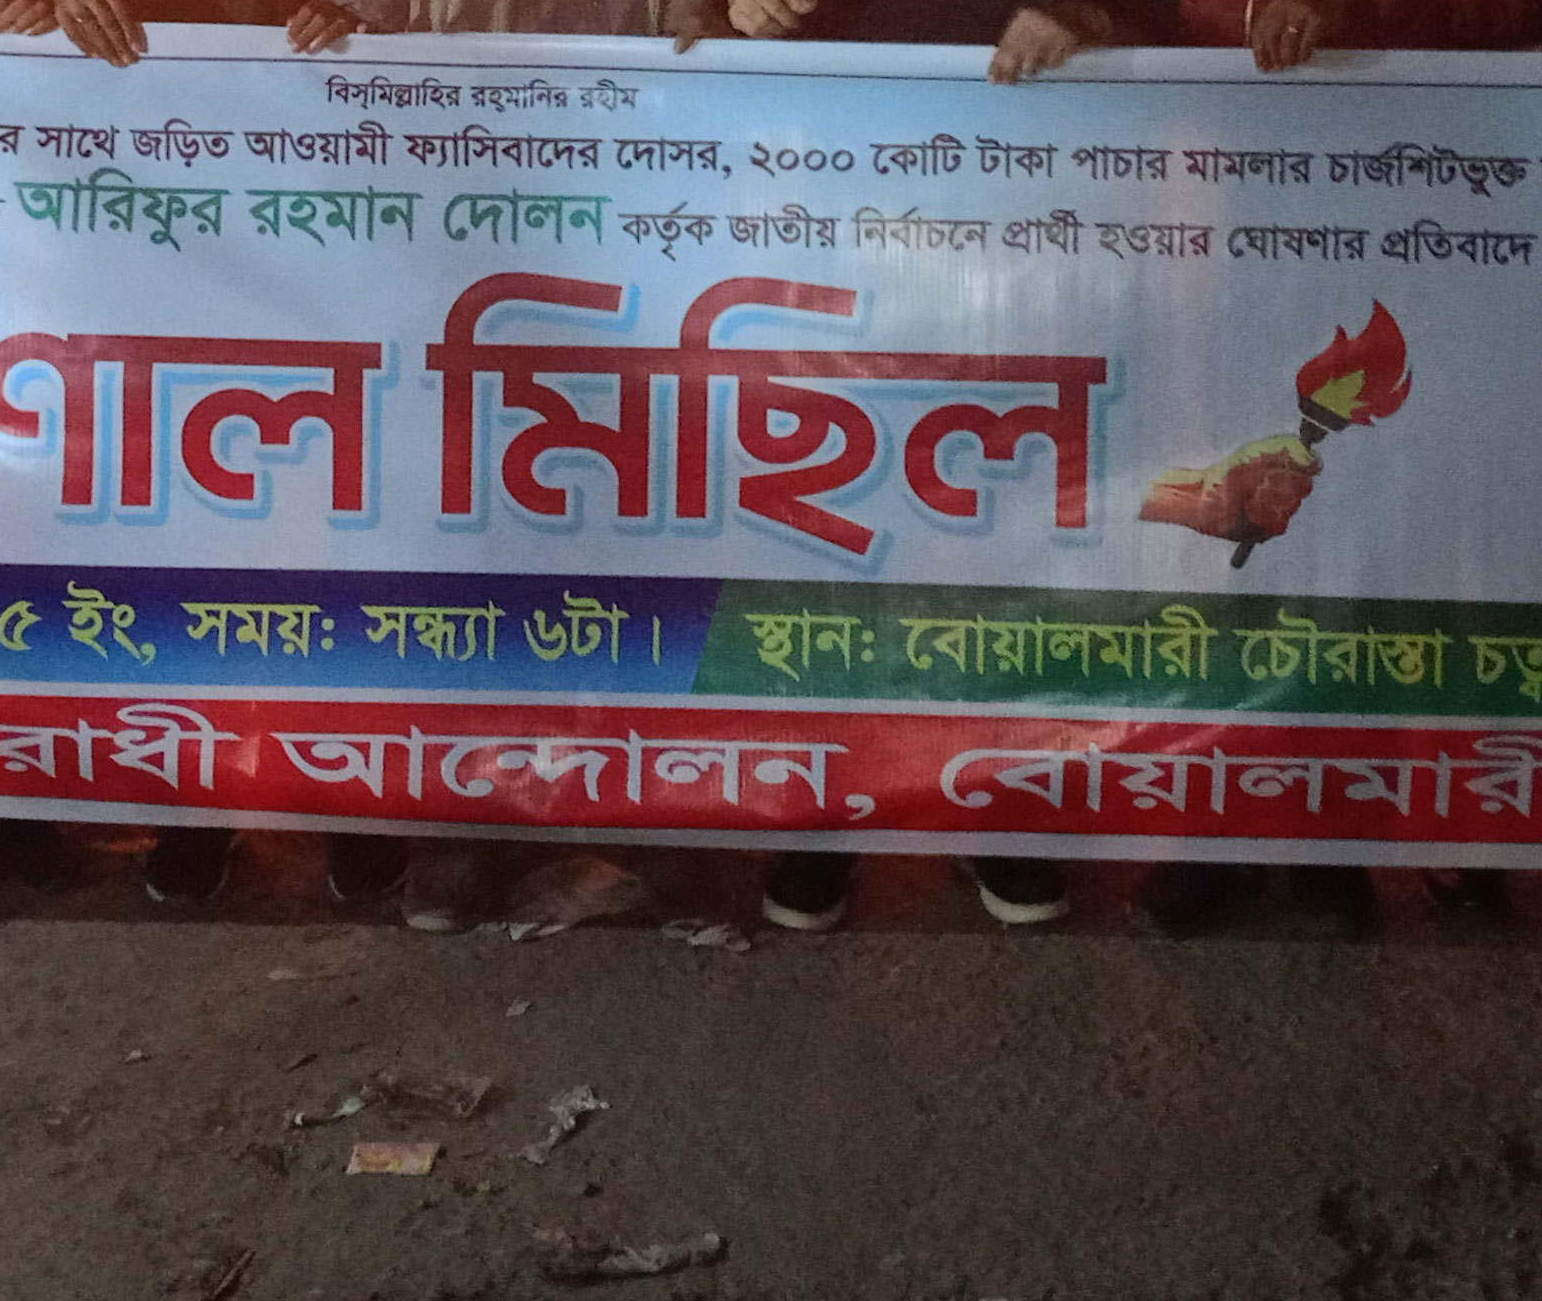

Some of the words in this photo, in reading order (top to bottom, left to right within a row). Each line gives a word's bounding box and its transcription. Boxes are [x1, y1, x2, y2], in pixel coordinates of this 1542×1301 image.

[579, 79, 640, 111] রহীম
[35, 124, 120, 161] সাথে
[130, 117, 235, 169] জড়িত
[243, 120, 393, 166] আওয়ামী
[402, 123, 603, 170] ফ্যাসিবাদের
[613, 137, 732, 180] দোসর,
[750, 141, 855, 178] ২০০০
[869, 134, 967, 176] কোটি
[975, 134, 1059, 178] টাকা
[1071, 145, 1173, 181] পাচার
[1183, 148, 1313, 185] মামলার
[13, 166, 231, 252] আরিফুর
[244, 184, 422, 248] রহমান
[444, 187, 612, 247] দোলন
[619, 201, 718, 262] কর্তৃক
[726, 204, 840, 249] জাতীয়
[851, 206, 992, 255] নির্বাচনে
[1001, 208, 1085, 255] প্রার্থী
[1095, 222, 1215, 260] হওয়ার
[1226, 223, 1370, 261] ঘোষণার
[1380, 219, 1539, 266] প্রতিবাদে
[424, 271, 1107, 556] মিছিল
[361, 603, 506, 660] সন্ধ্যা
[524, 591, 629, 664] ৬টা
[899, 602, 1219, 682] বোয়ালমারী
[1233, 608, 1455, 688] চৌরাস্তা
[273, 726, 877, 818] আন্দোলন,
